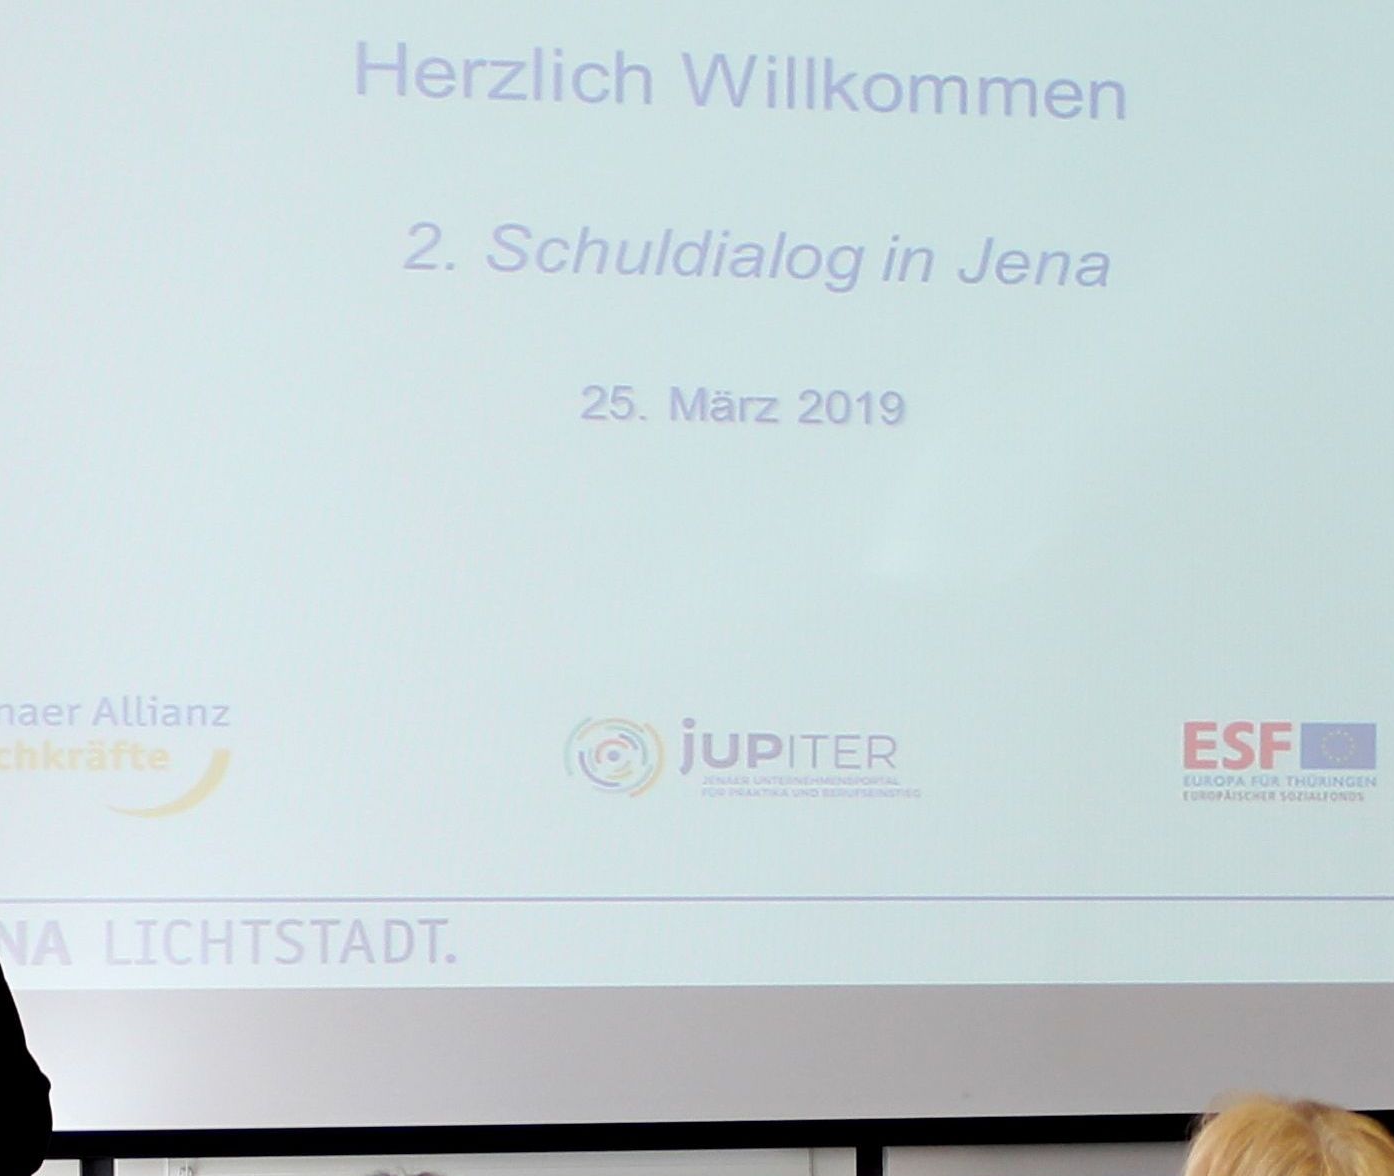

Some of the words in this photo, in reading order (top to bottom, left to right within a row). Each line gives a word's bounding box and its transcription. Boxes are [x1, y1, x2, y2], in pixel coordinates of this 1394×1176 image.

[354, 40, 654, 107] Herzlich
[682, 50, 1128, 121] Willkommen
[402, 221, 457, 273] 2.
[486, 222, 865, 294] Schuldialog
[881, 234, 934, 284] in
[958, 237, 1110, 289] Jena
[579, 383, 648, 423] 25.
[668, 385, 778, 425] März
[797, 388, 906, 428] 2019
[93, 695, 231, 728] Allianz
[1182, 721, 1293, 771] ESF
[1182, 775, 1246, 788] EUROPA
[1251, 773, 1280, 788] FÜR
[1286, 773, 1378, 789] THÜRINGEN
[105, 917, 458, 967] LICHTSTADT.
